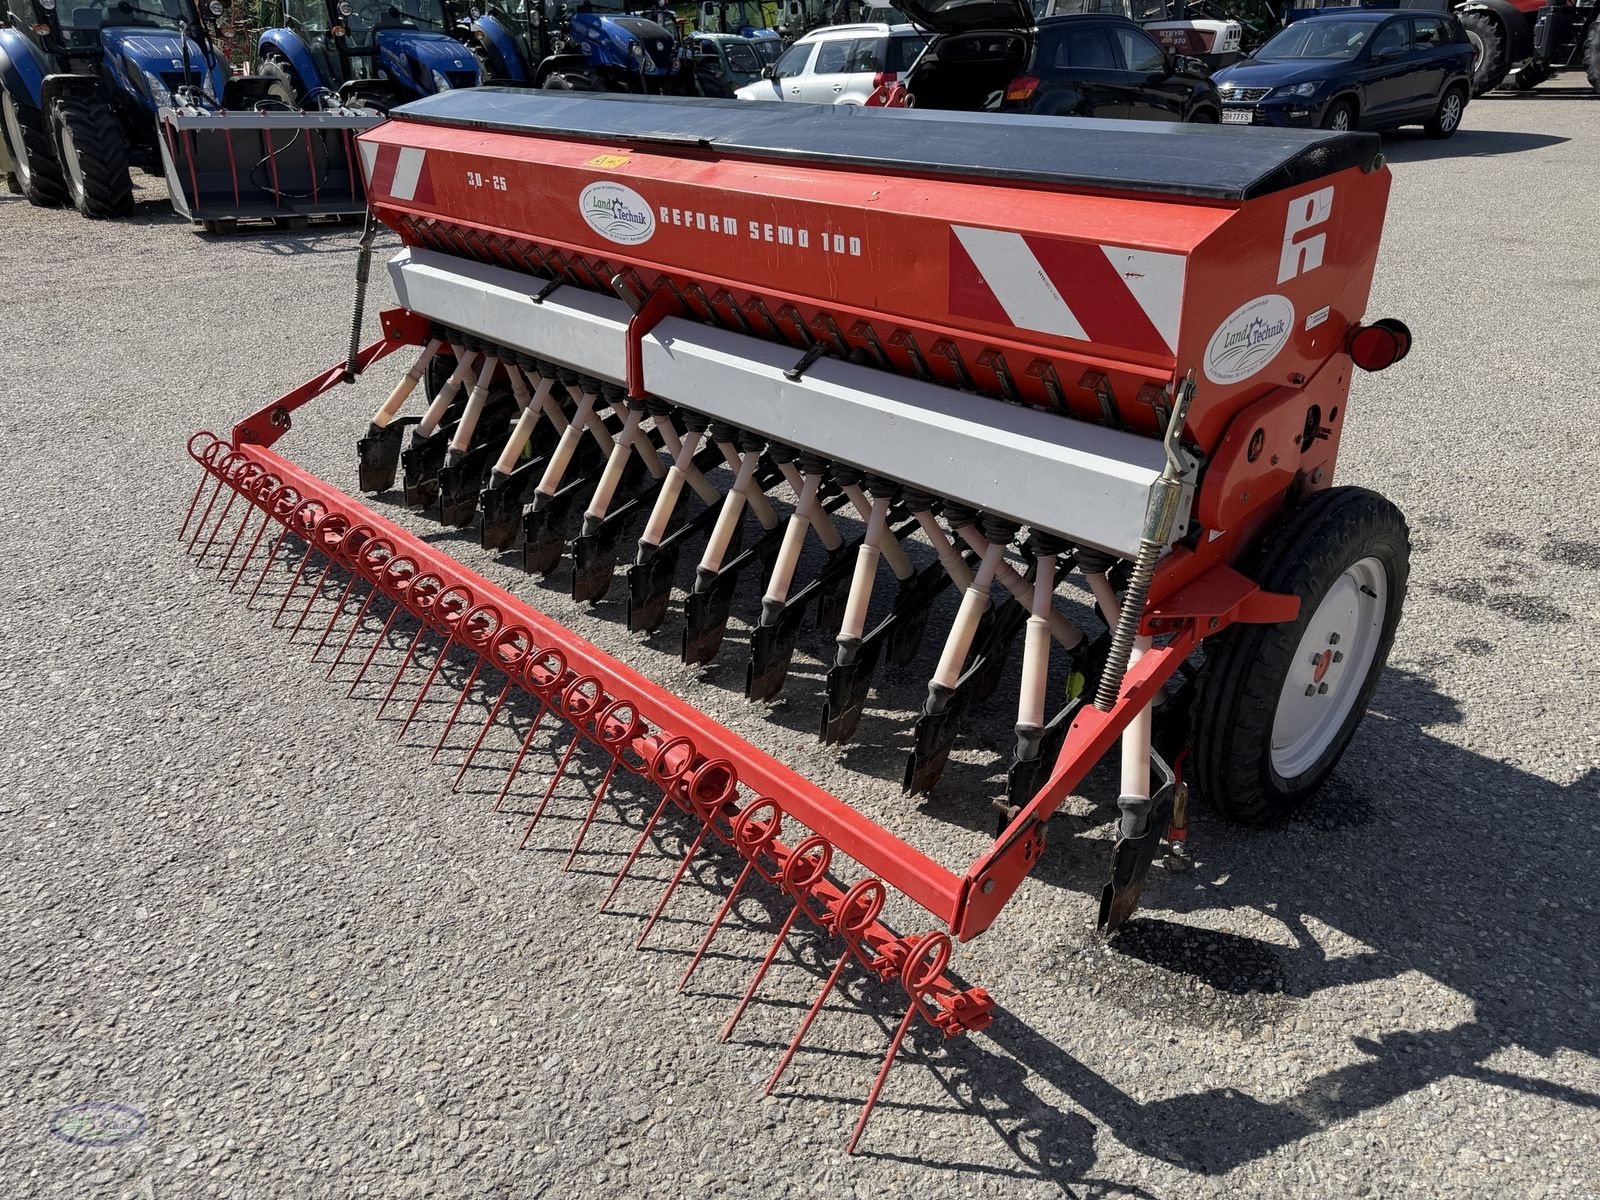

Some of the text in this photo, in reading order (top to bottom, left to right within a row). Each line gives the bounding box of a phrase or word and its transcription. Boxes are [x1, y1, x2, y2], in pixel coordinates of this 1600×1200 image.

[492, 175, 507, 191] 25
[593, 196, 611, 210] Land
[617, 208, 647, 225] Technik
[659, 206, 738, 236] REFORM
[749, 221, 810, 248] SEMO
[821, 232, 861, 257] 100
[1223, 323, 1248, 349] Land
[1252, 319, 1285, 346] Technik
